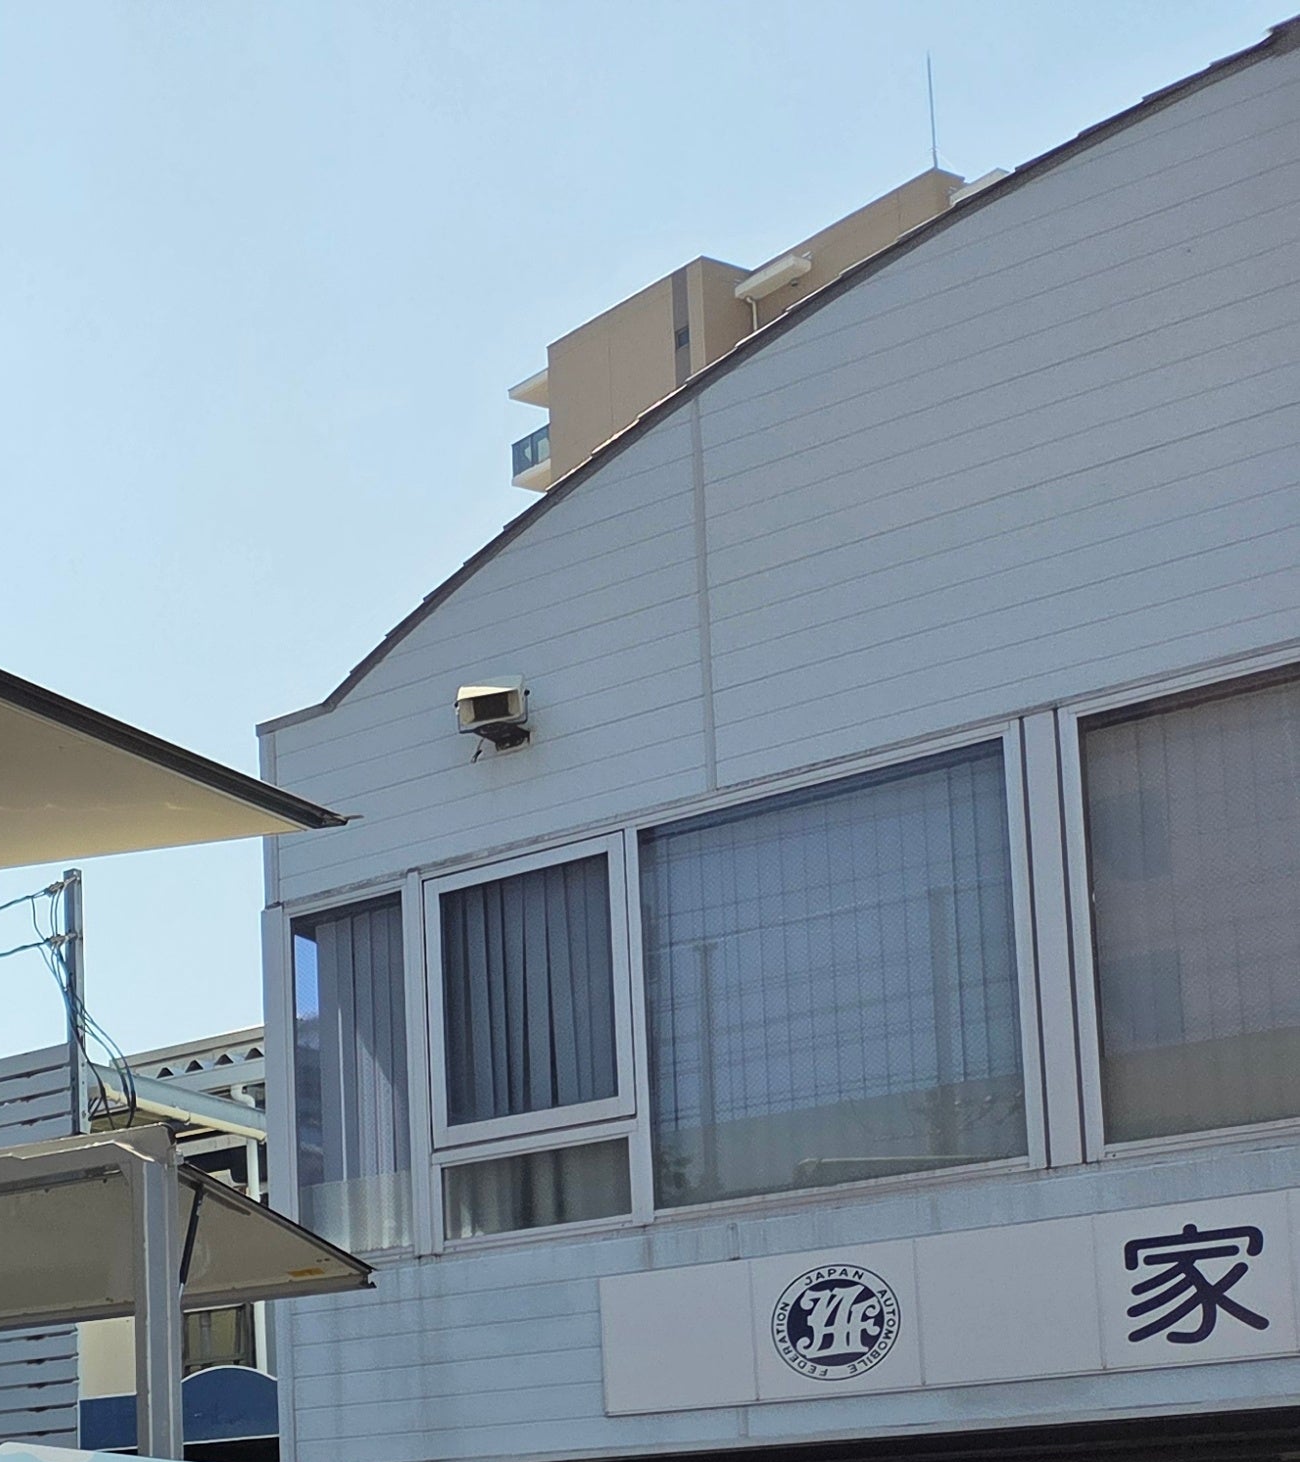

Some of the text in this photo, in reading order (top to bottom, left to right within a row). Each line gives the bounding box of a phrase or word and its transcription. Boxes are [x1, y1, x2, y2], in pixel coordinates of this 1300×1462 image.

[775, 1268, 897, 1377] JAPAN AUTOMOBILE FEDERATION
[1123, 1223, 1270, 1345] 家
